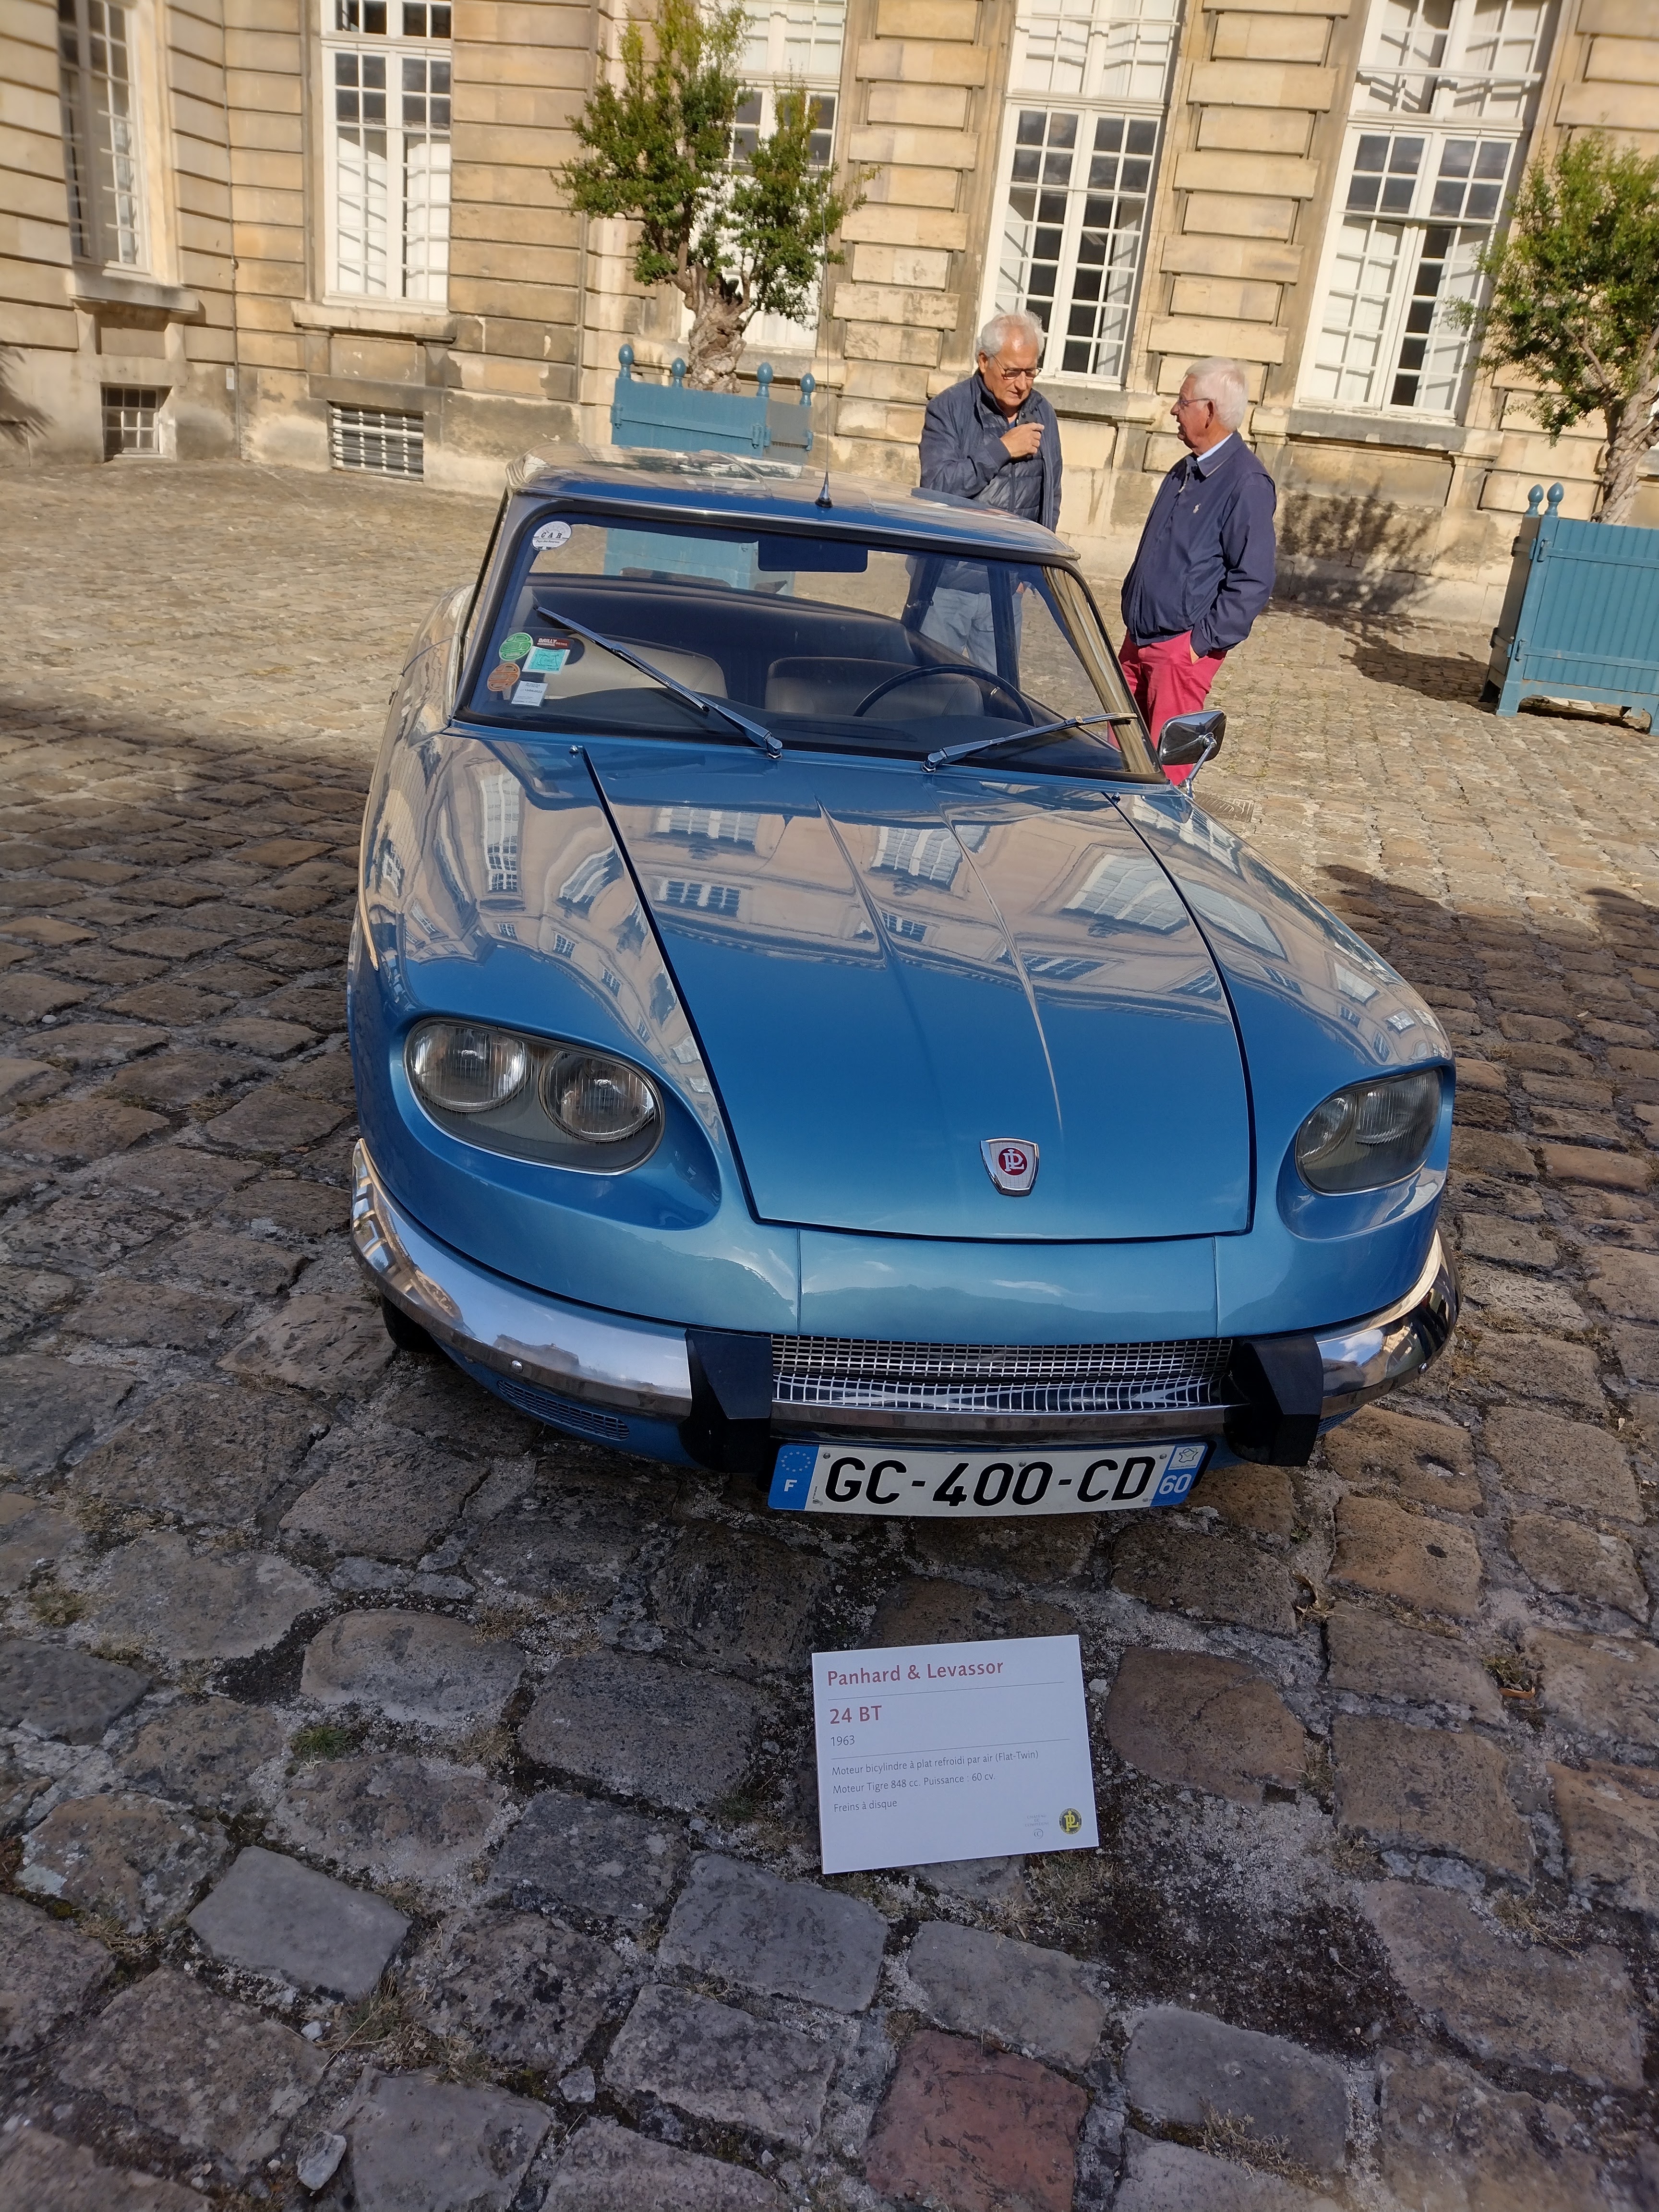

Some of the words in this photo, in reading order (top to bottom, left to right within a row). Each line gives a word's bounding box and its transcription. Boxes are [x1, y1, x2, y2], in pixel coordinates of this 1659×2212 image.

[784, 1479, 797, 1491] F
[825, 1456, 1156, 1507] GC-400-CD
[1159, 1474, 1191, 1494] 60
[828, 1664, 901, 1686] Panhard
[907, 1664, 921, 1680] &
[927, 1662, 1004, 1679] Levassor
[830, 1707, 853, 1724] 24
[859, 1705, 882, 1722] BT
[830, 1735, 855, 1746] 1963
[832, 1767, 864, 1776] Moteur
[866, 1761, 907, 1774] bicylindre
[910, 1760, 915, 1769] à
[916, 1759, 932, 1771] plat
[934, 1755, 965, 1767] refroidi
[967, 1756, 981, 1767] par
[983, 1754, 993, 1763] air
[995, 1750, 1038, 1763] (Flat-Twin)
[833, 1785, 865, 1794] Moteur
[866, 1781, 889, 1793] Tigre
[891, 1779, 907, 1789] 848
[924, 1776, 964, 1786] Puissance
[972, 1772, 982, 1781] 60
[834, 1803, 859, 1813] Freins
[862, 1801, 867, 1810] à
[869, 1800, 897, 1810] disque
